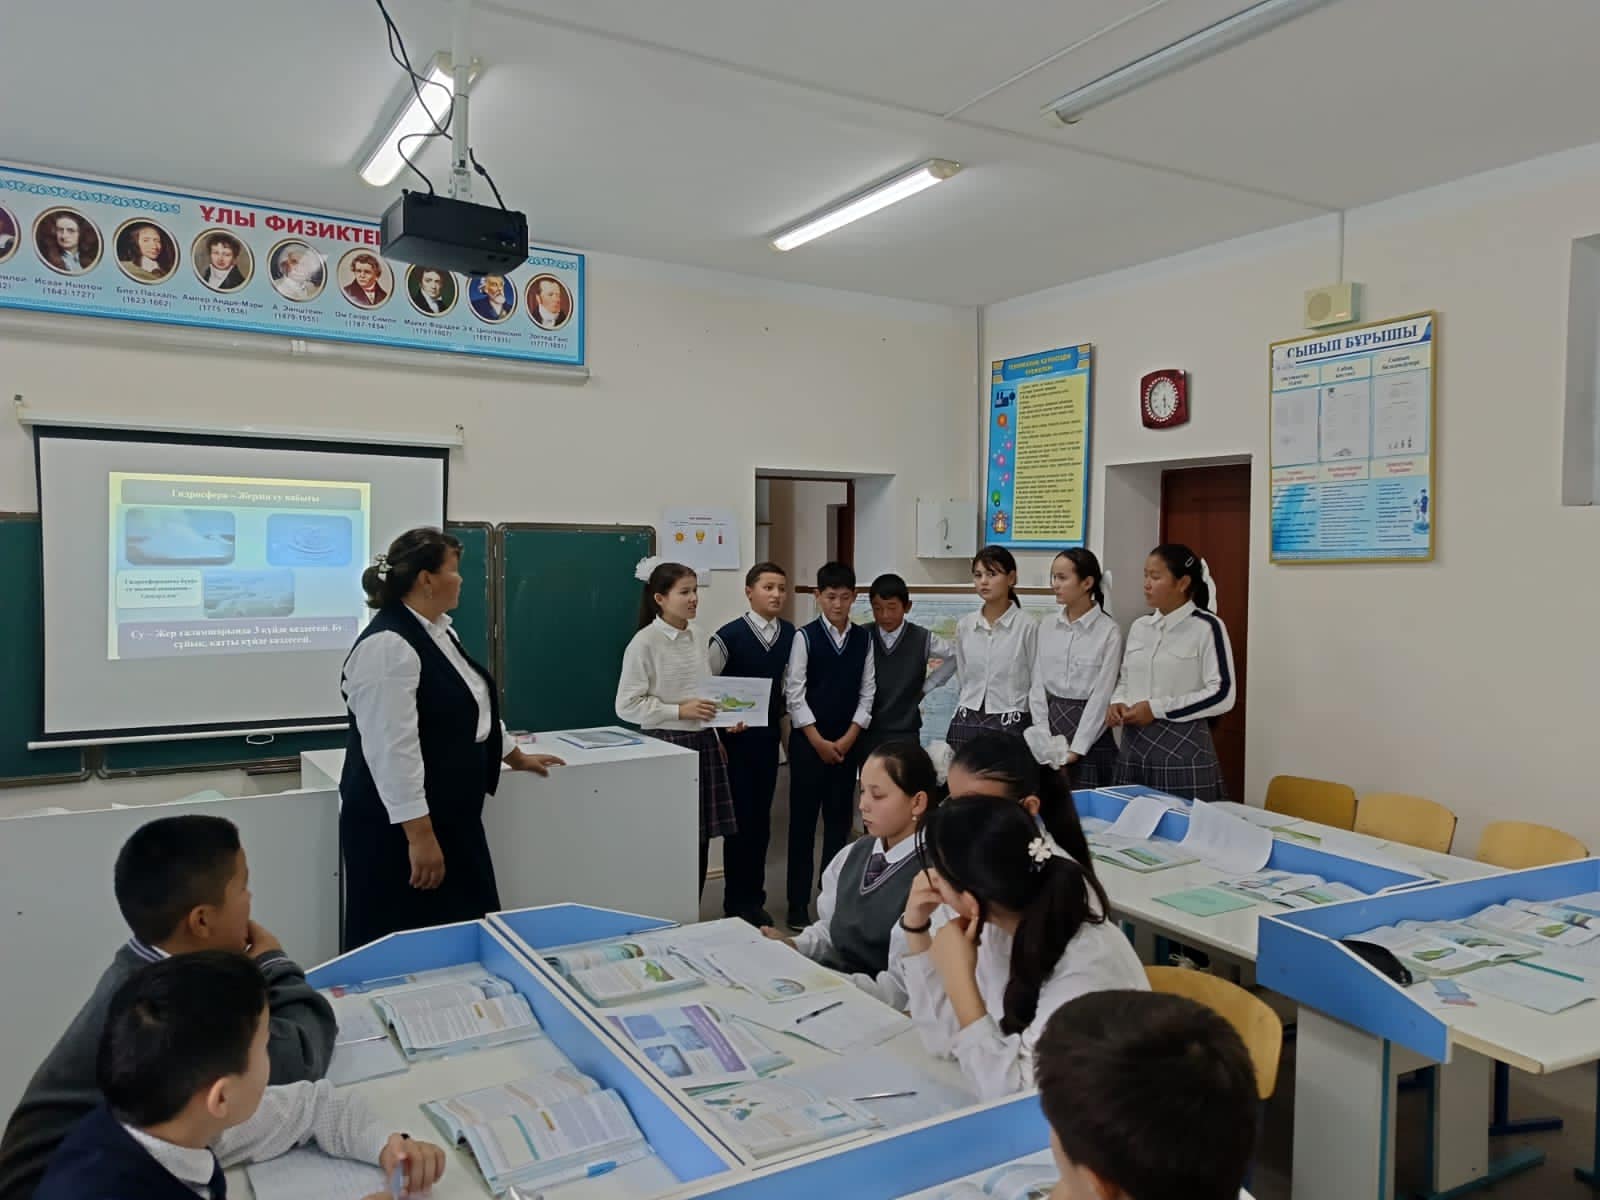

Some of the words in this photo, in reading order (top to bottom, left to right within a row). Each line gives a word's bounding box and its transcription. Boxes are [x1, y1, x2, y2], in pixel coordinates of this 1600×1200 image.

[200, 205, 256, 228] ҰЛЫ
[65, 280, 102, 291] Ньютон
[140, 288, 178, 300] Паскаль
[182, 292, 211, 304] Ампер
[1287, 339, 1341, 358] СЫНЫП
[1345, 325, 1417, 349] БҰРЫШЫ
